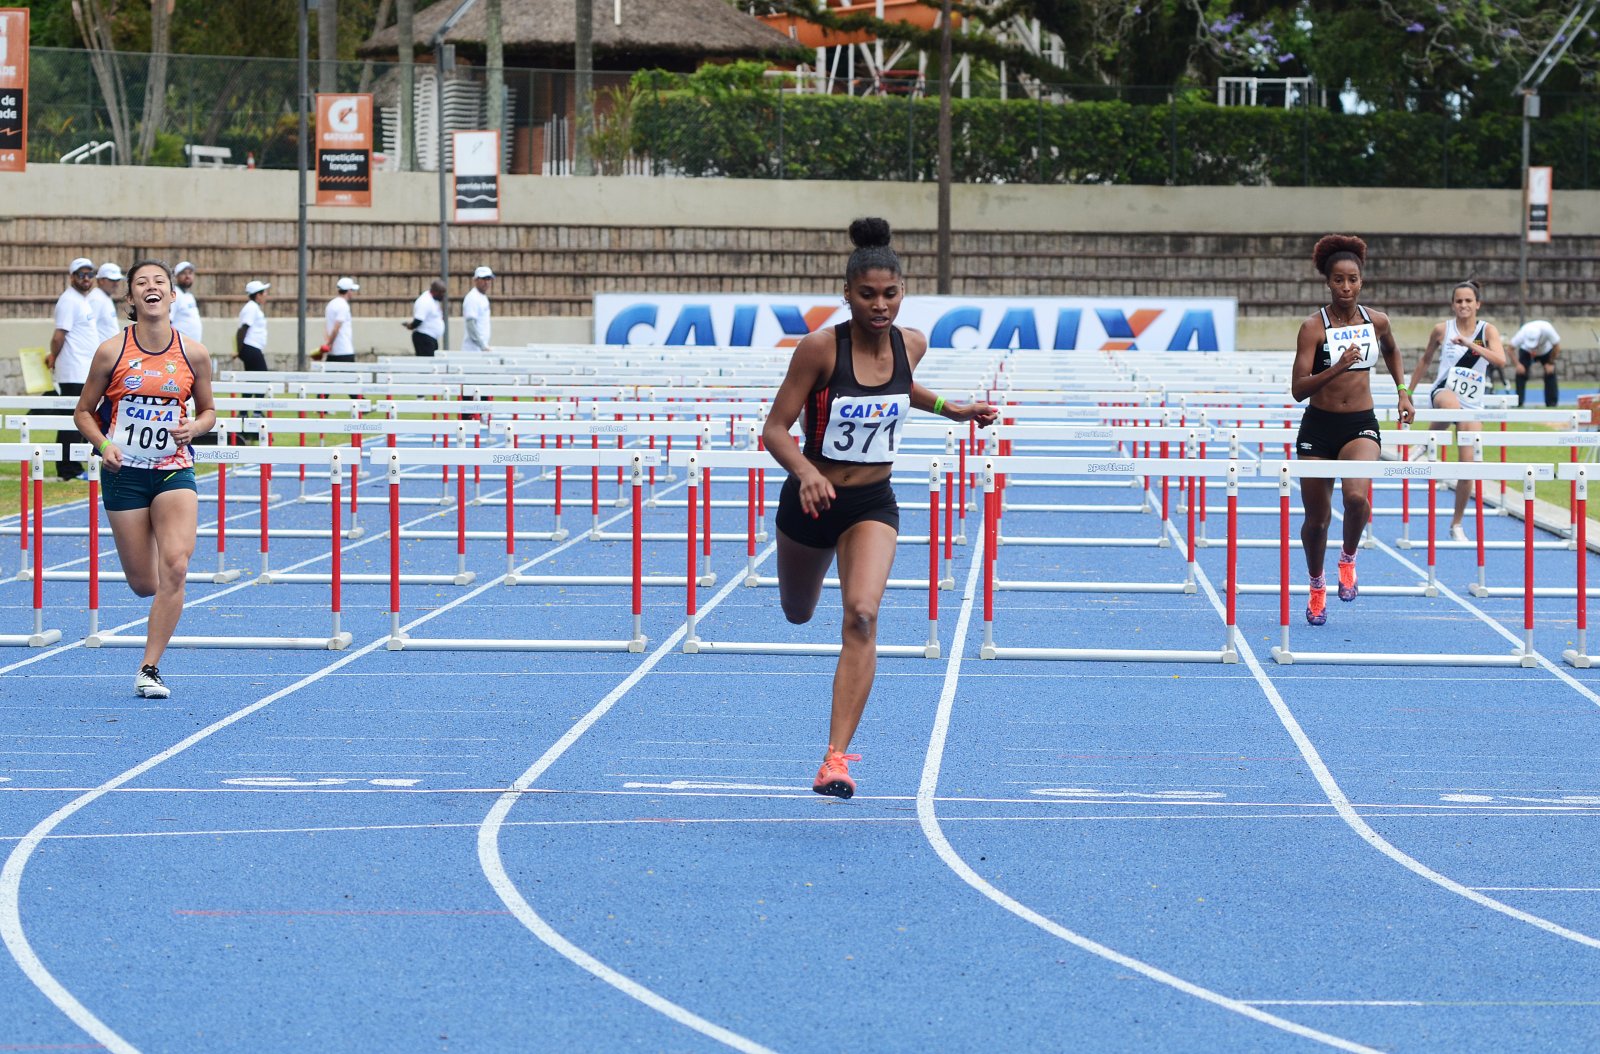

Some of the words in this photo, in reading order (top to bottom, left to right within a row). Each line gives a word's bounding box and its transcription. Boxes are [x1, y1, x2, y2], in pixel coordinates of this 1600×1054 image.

[2, 95, 16, 106] de
[322, 153, 365, 162] repetições
[329, 162, 358, 172] longas
[605, 303, 840, 347] CAIX
[929, 305, 1220, 351] CAIXA
[1334, 329, 1370, 340] CAIXA
[1455, 368, 1483, 383] CAIXA
[1452, 379, 1478, 399] 192
[126, 406, 173, 422] CAIXA
[839, 402, 899, 419] CAIXA
[124, 423, 169, 450] 109
[833, 418, 898, 454] 371
[1384, 466, 1432, 477] sportland
